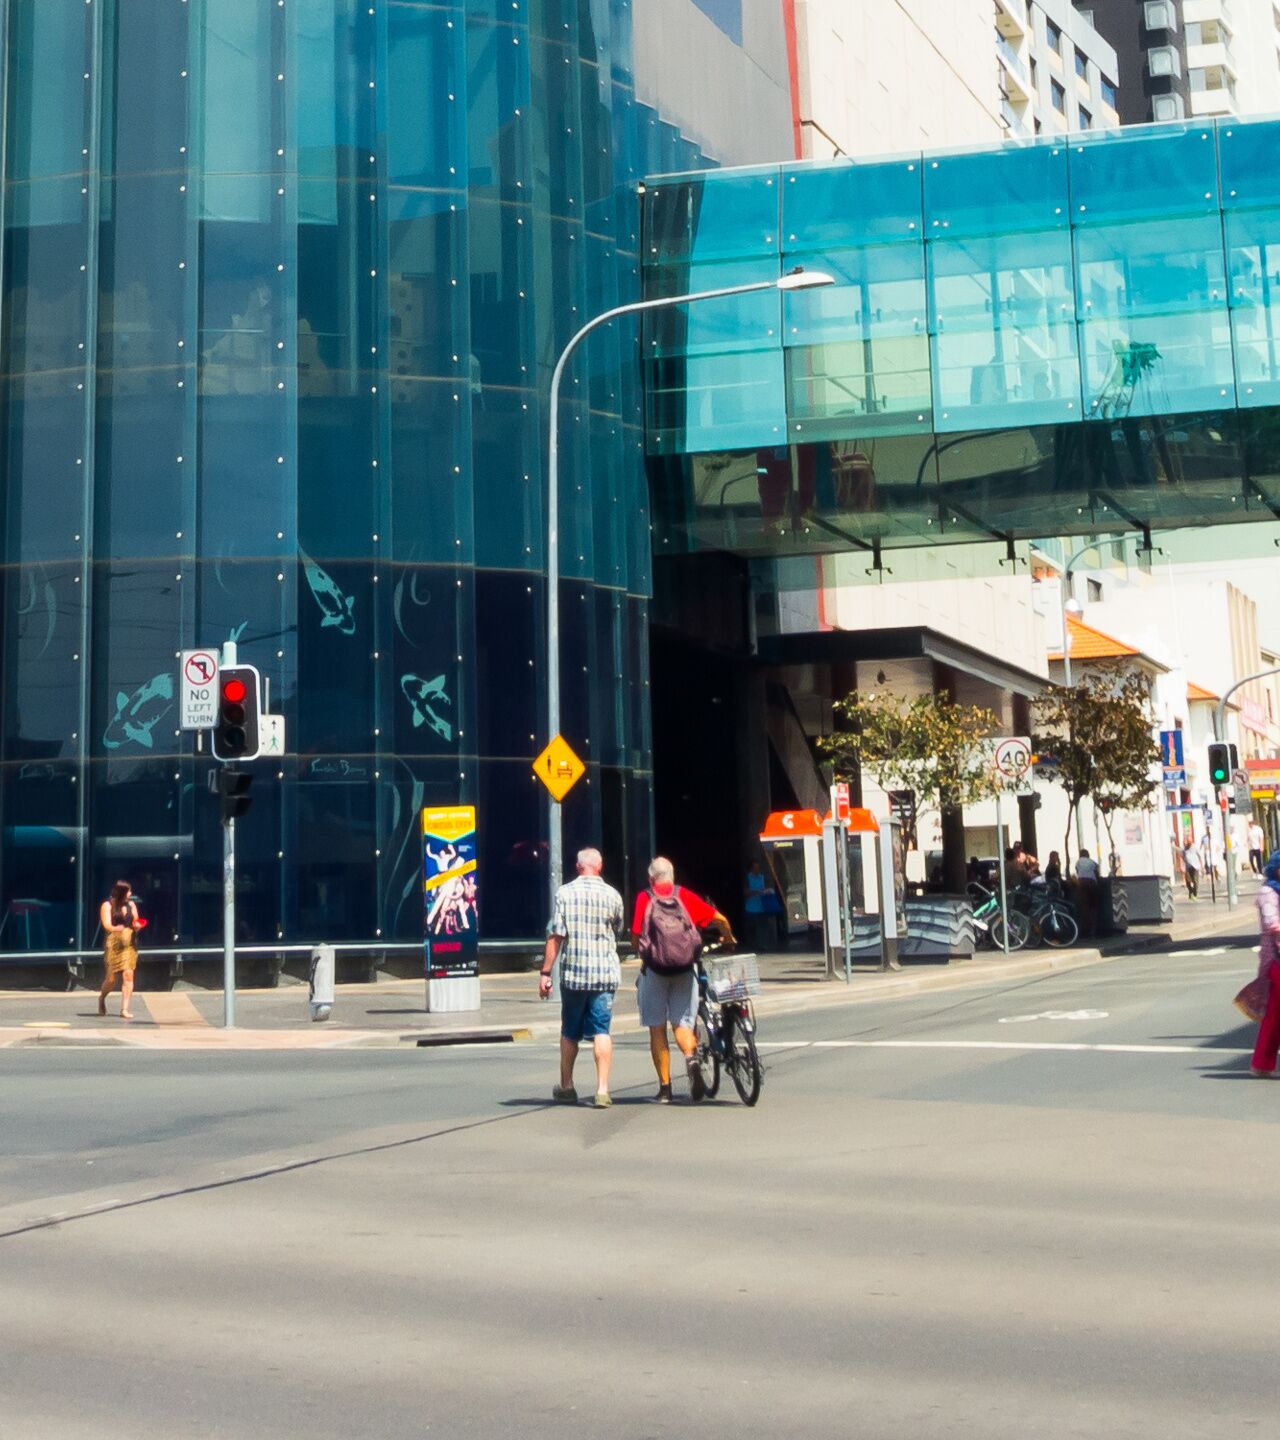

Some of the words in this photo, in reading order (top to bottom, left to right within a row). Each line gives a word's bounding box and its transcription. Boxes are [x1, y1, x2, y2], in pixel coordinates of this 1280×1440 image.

[190, 689, 210, 701] NO
[187, 703, 212, 712] LEFT
[187, 715, 213, 723] TURN
[1001, 750, 1026, 767] 40
